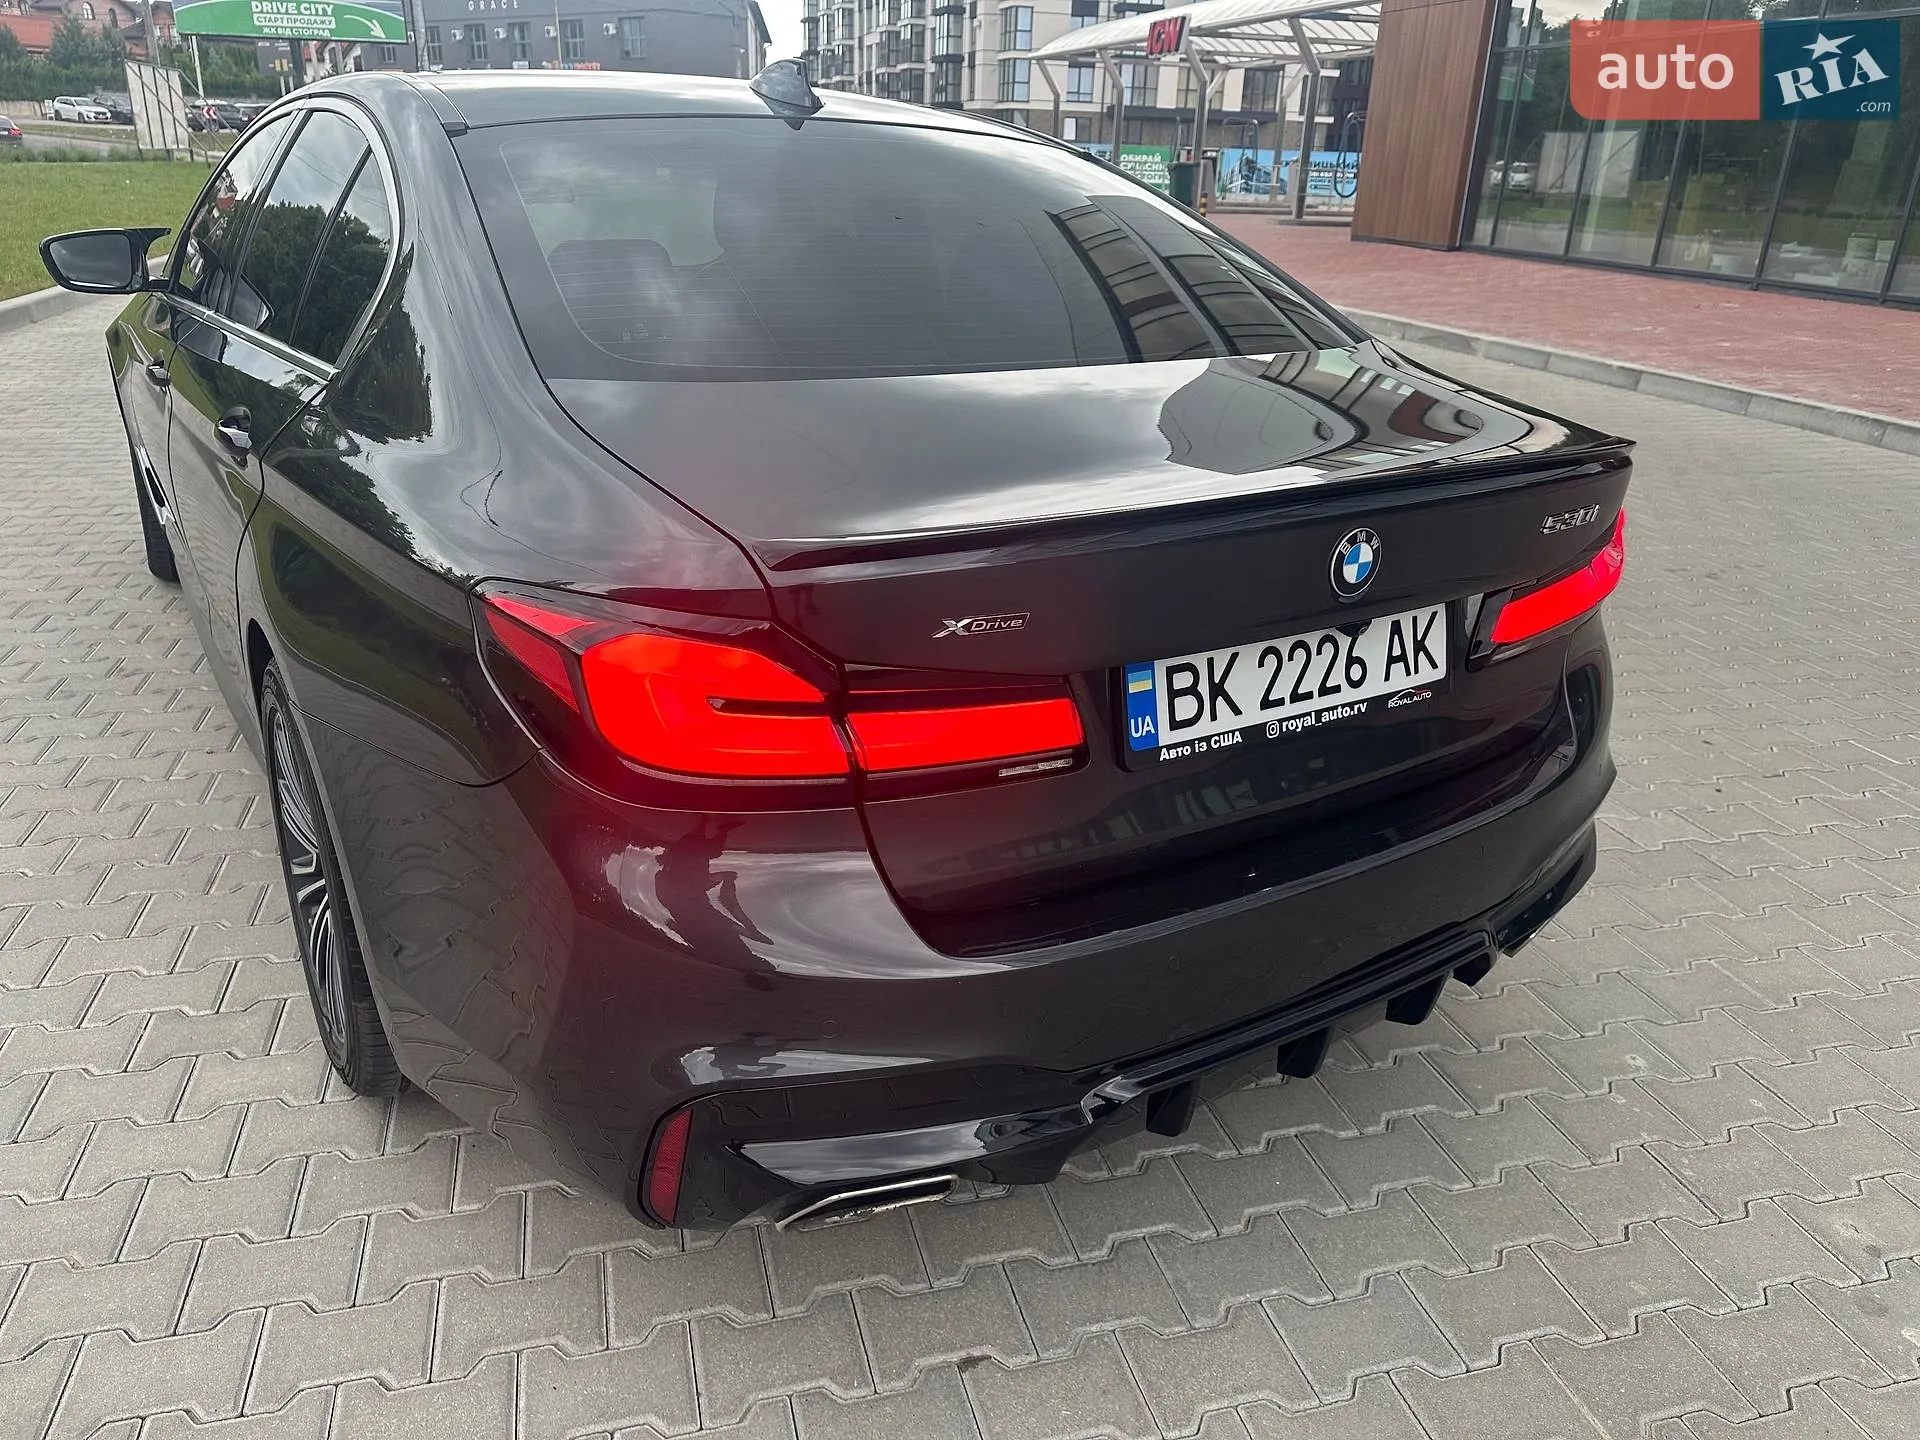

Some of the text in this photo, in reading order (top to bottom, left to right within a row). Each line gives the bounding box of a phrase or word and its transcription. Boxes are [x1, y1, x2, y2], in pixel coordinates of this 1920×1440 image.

[251, 1, 334, 15] DRIVE CITY
[256, 16, 333, 26] СТАРТ ПРОДАЖУ
[277, 28, 292, 36] ВІД
[292, 29, 331, 37] СТОГРАД
[1120, 153, 1161, 161] ОБИРАЙ
[1540, 504, 1600, 535] 530i
[1340, 530, 1380, 555] BMW
[1166, 611, 1439, 732] BK 2226 AK
[1131, 715, 1155, 738] UA
[1282, 702, 1368, 734] royal_auto.rv
[1160, 731, 1243, 761] Авто із США
